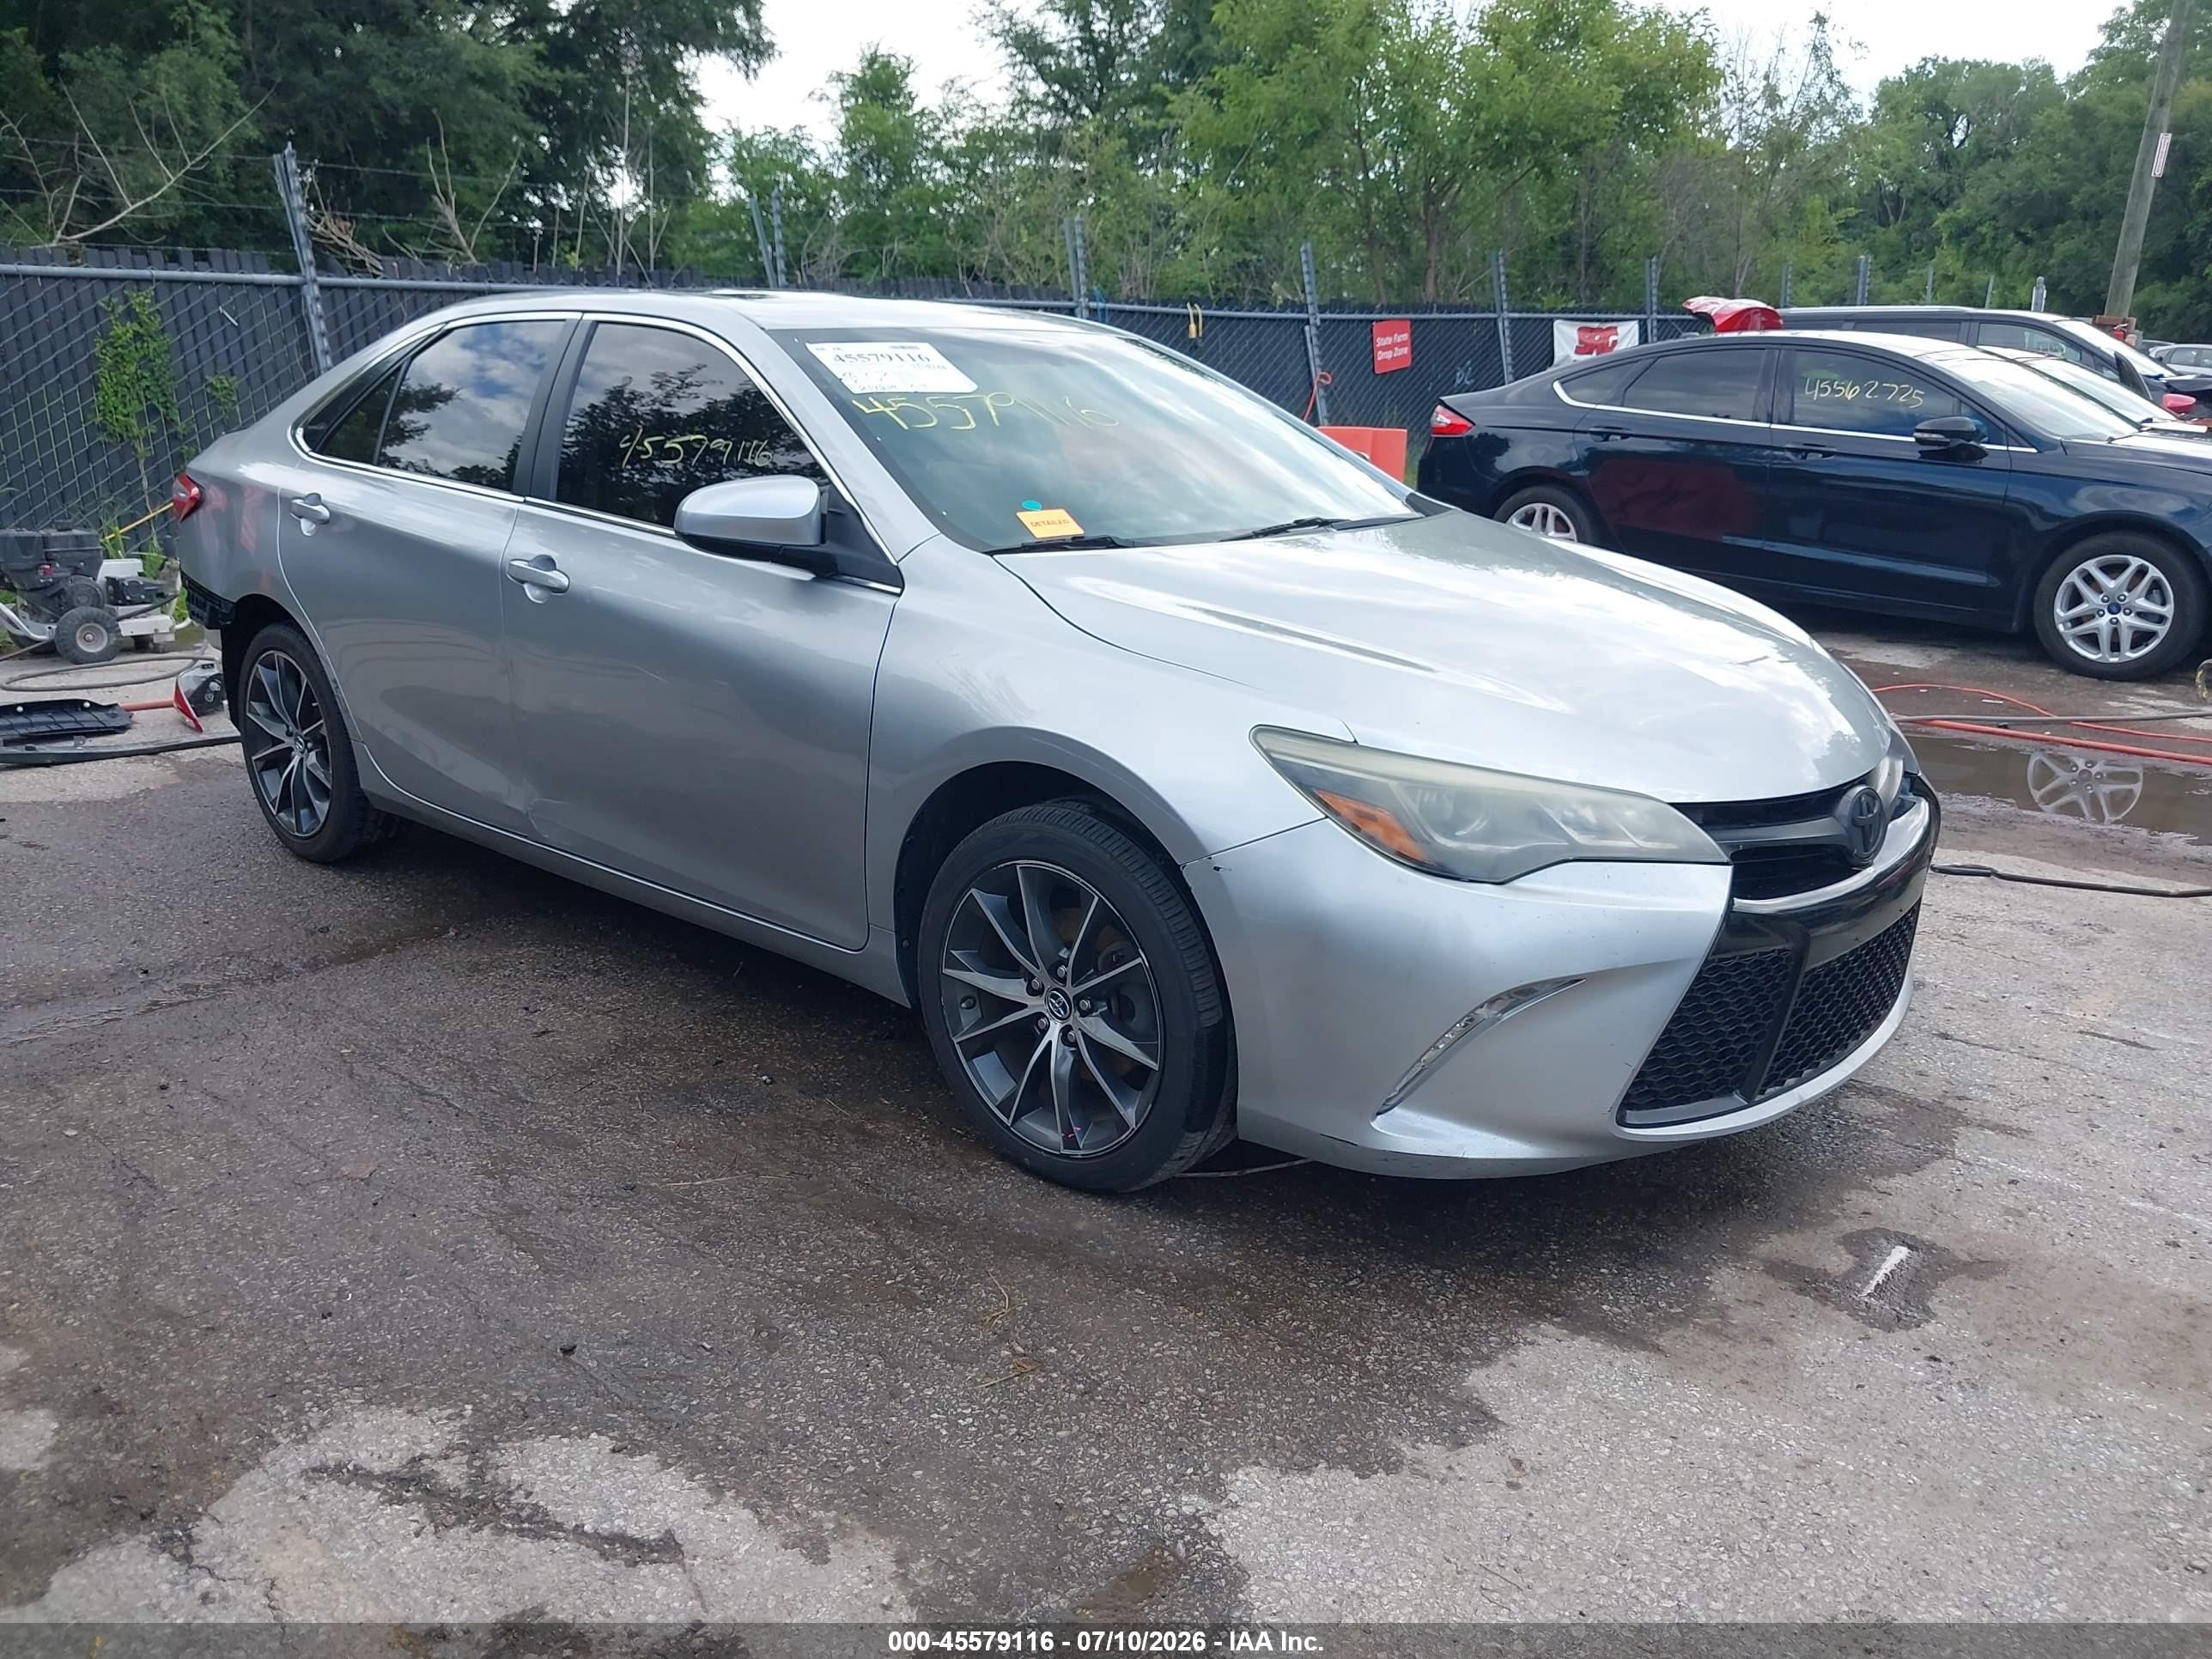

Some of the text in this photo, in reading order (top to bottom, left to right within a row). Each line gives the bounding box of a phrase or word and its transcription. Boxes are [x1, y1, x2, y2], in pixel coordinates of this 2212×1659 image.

[833, 352, 931, 363] 45579116
[1805, 377, 1925, 409] 45562725
[852, 392, 1120, 430] 45579116
[619, 428, 773, 468] 45579116
